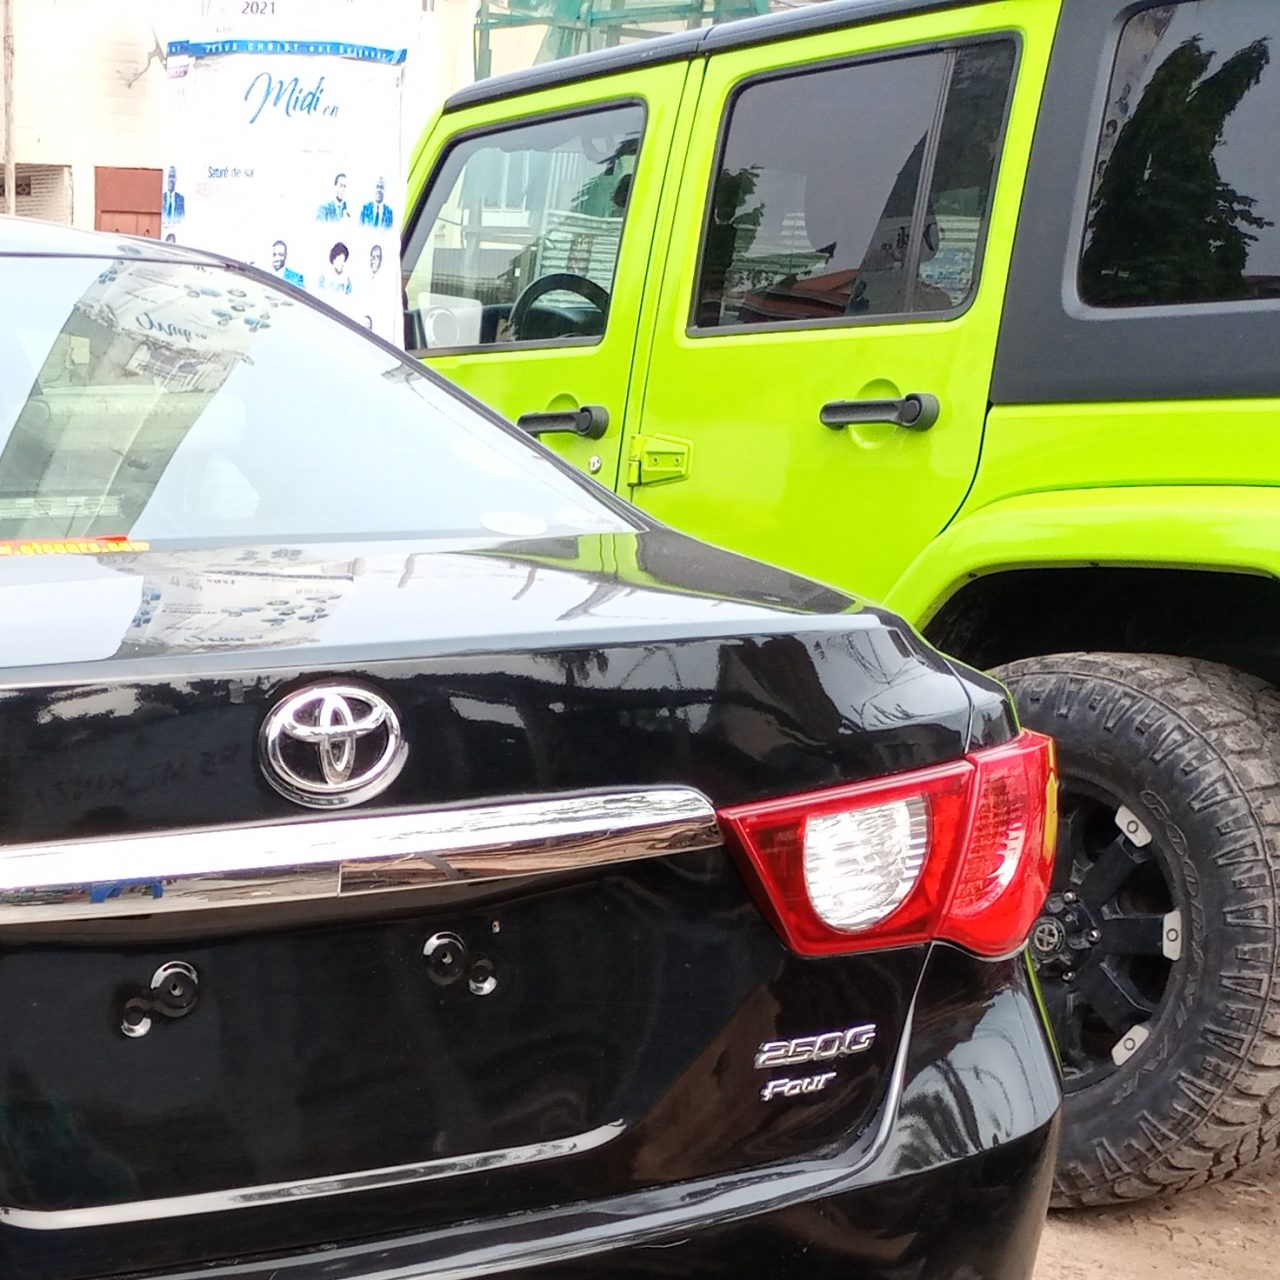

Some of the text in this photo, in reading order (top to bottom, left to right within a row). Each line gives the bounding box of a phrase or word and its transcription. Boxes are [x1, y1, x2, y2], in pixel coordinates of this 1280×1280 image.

[241, 1, 276, 15] 2021
[205, 43, 238, 54] JESUS
[247, 42, 300, 54] CHRIST
[244, 71, 339, 125] Midi en
[230, 167, 242, 178] de
[753, 1023, 877, 1070] 250G
[760, 1071, 837, 1102] Four
